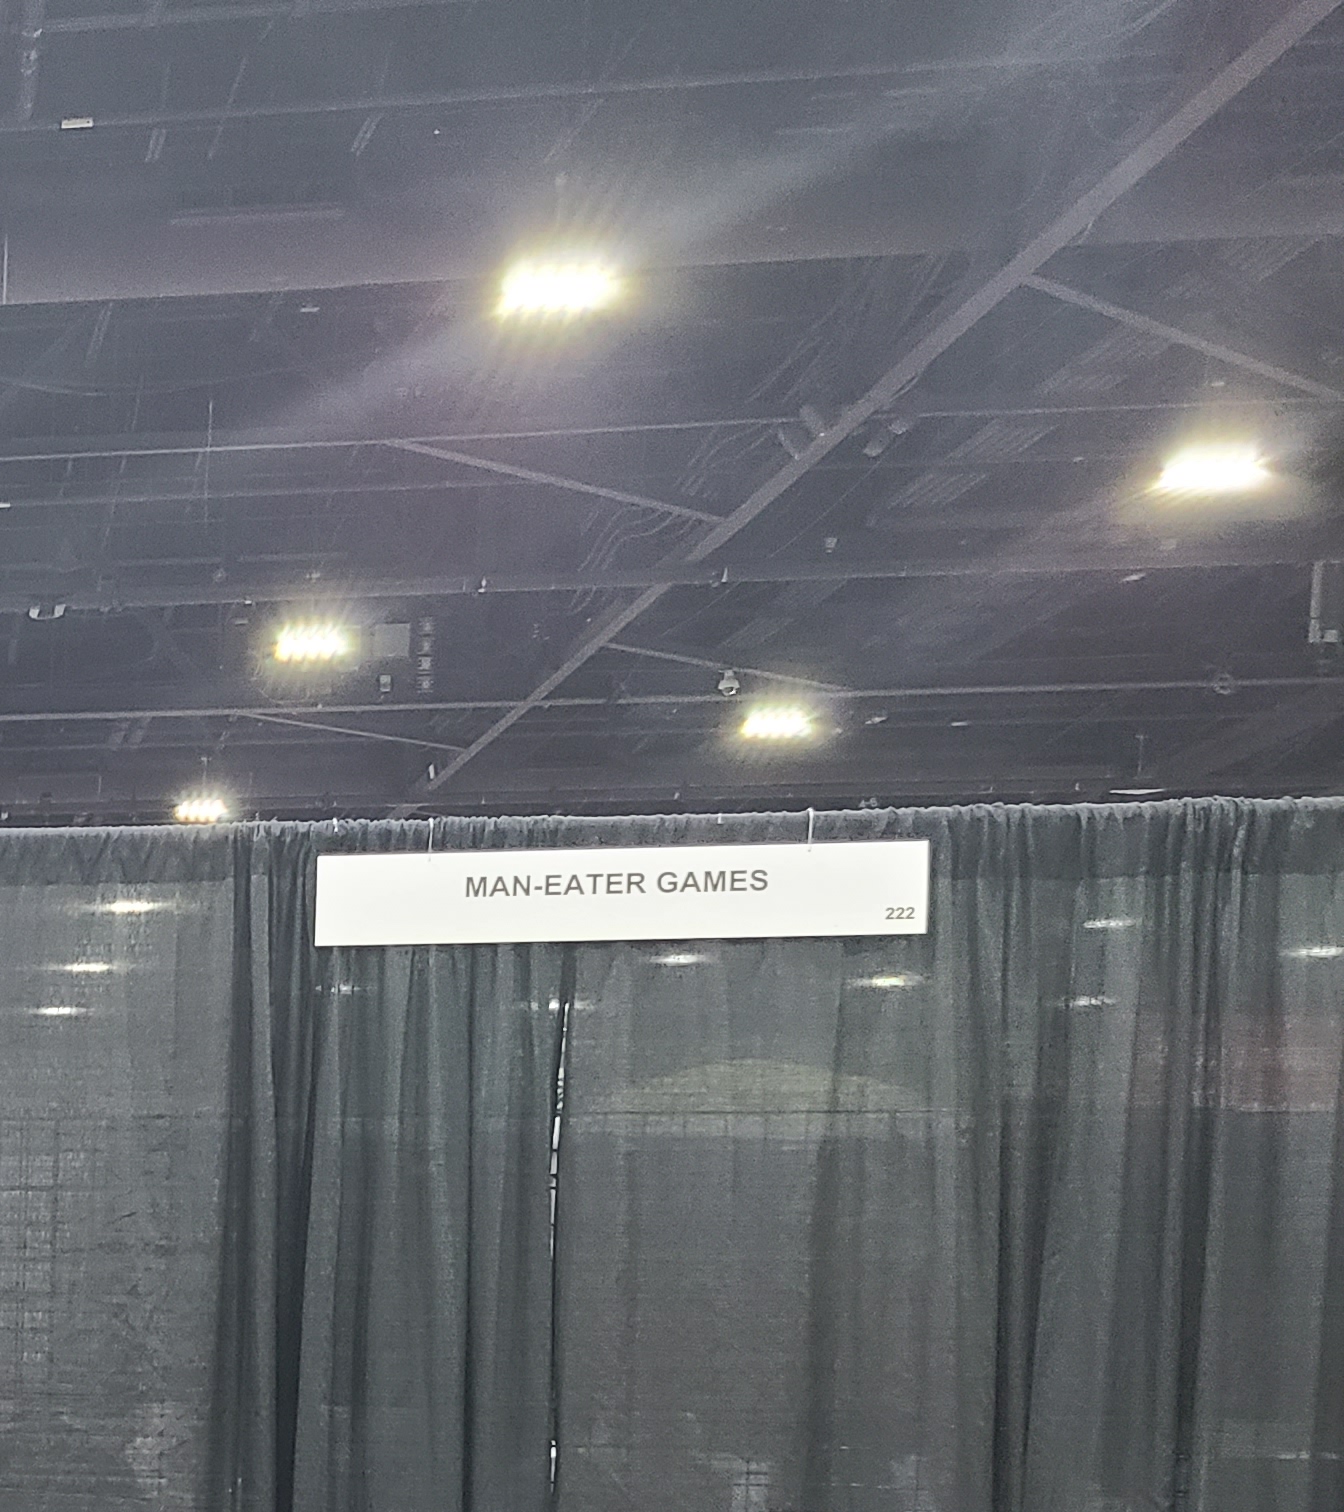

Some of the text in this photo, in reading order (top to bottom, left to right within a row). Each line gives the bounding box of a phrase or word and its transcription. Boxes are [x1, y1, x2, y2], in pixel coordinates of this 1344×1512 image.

[465, 869, 770, 898] MAN-EATER GAMES
[885, 906, 916, 921] 222
